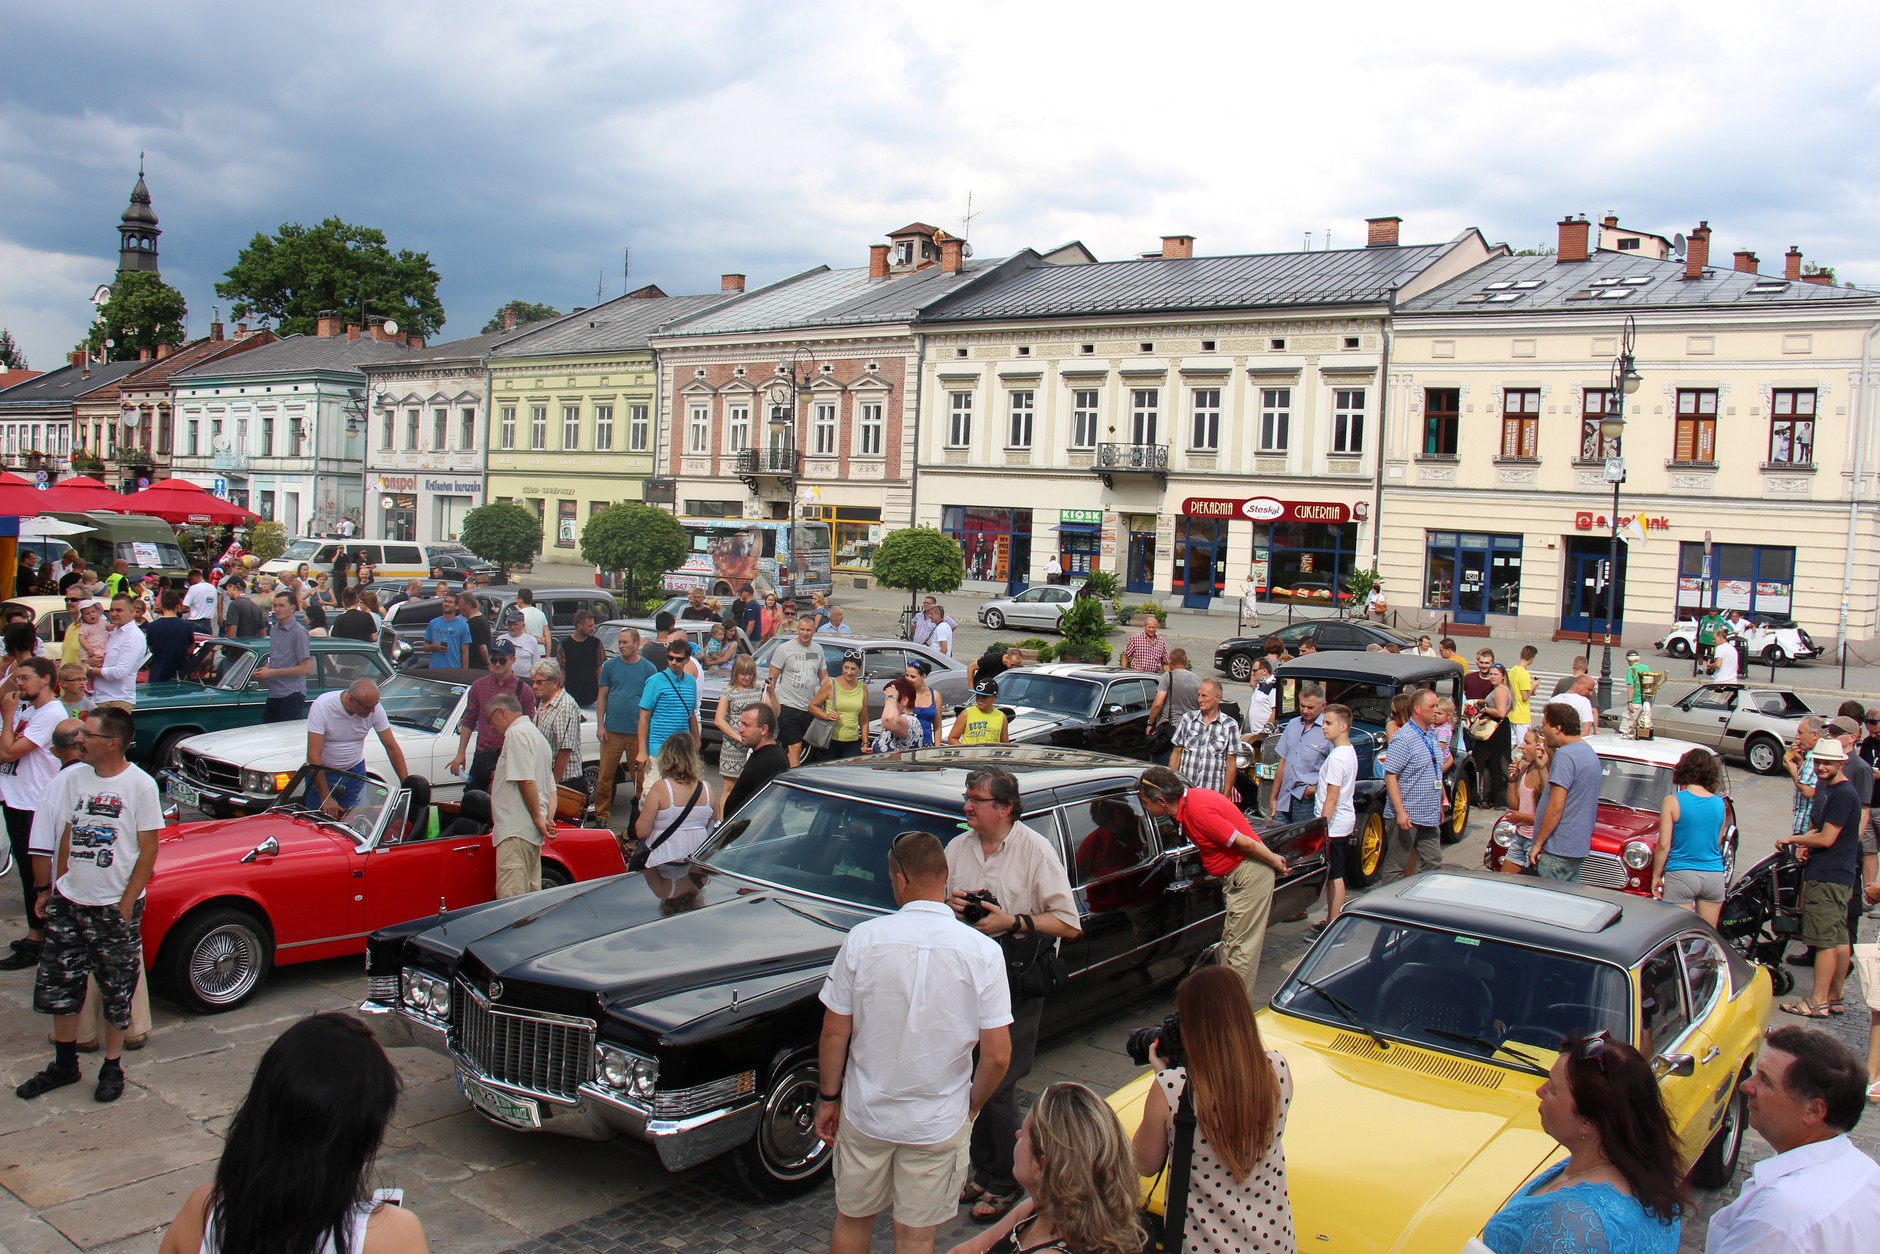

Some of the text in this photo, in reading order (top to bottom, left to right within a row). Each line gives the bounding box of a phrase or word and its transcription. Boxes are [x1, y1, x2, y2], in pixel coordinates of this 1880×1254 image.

[379, 473, 417, 493] onspol
[1062, 511, 1100, 520] KIOSK
[1190, 501, 1234, 516] PIEKARNIA
[1294, 505, 1340, 520] CUKIERNIA
[969, 721, 987, 731] BEST
[482, 1089, 497, 1104] 23
